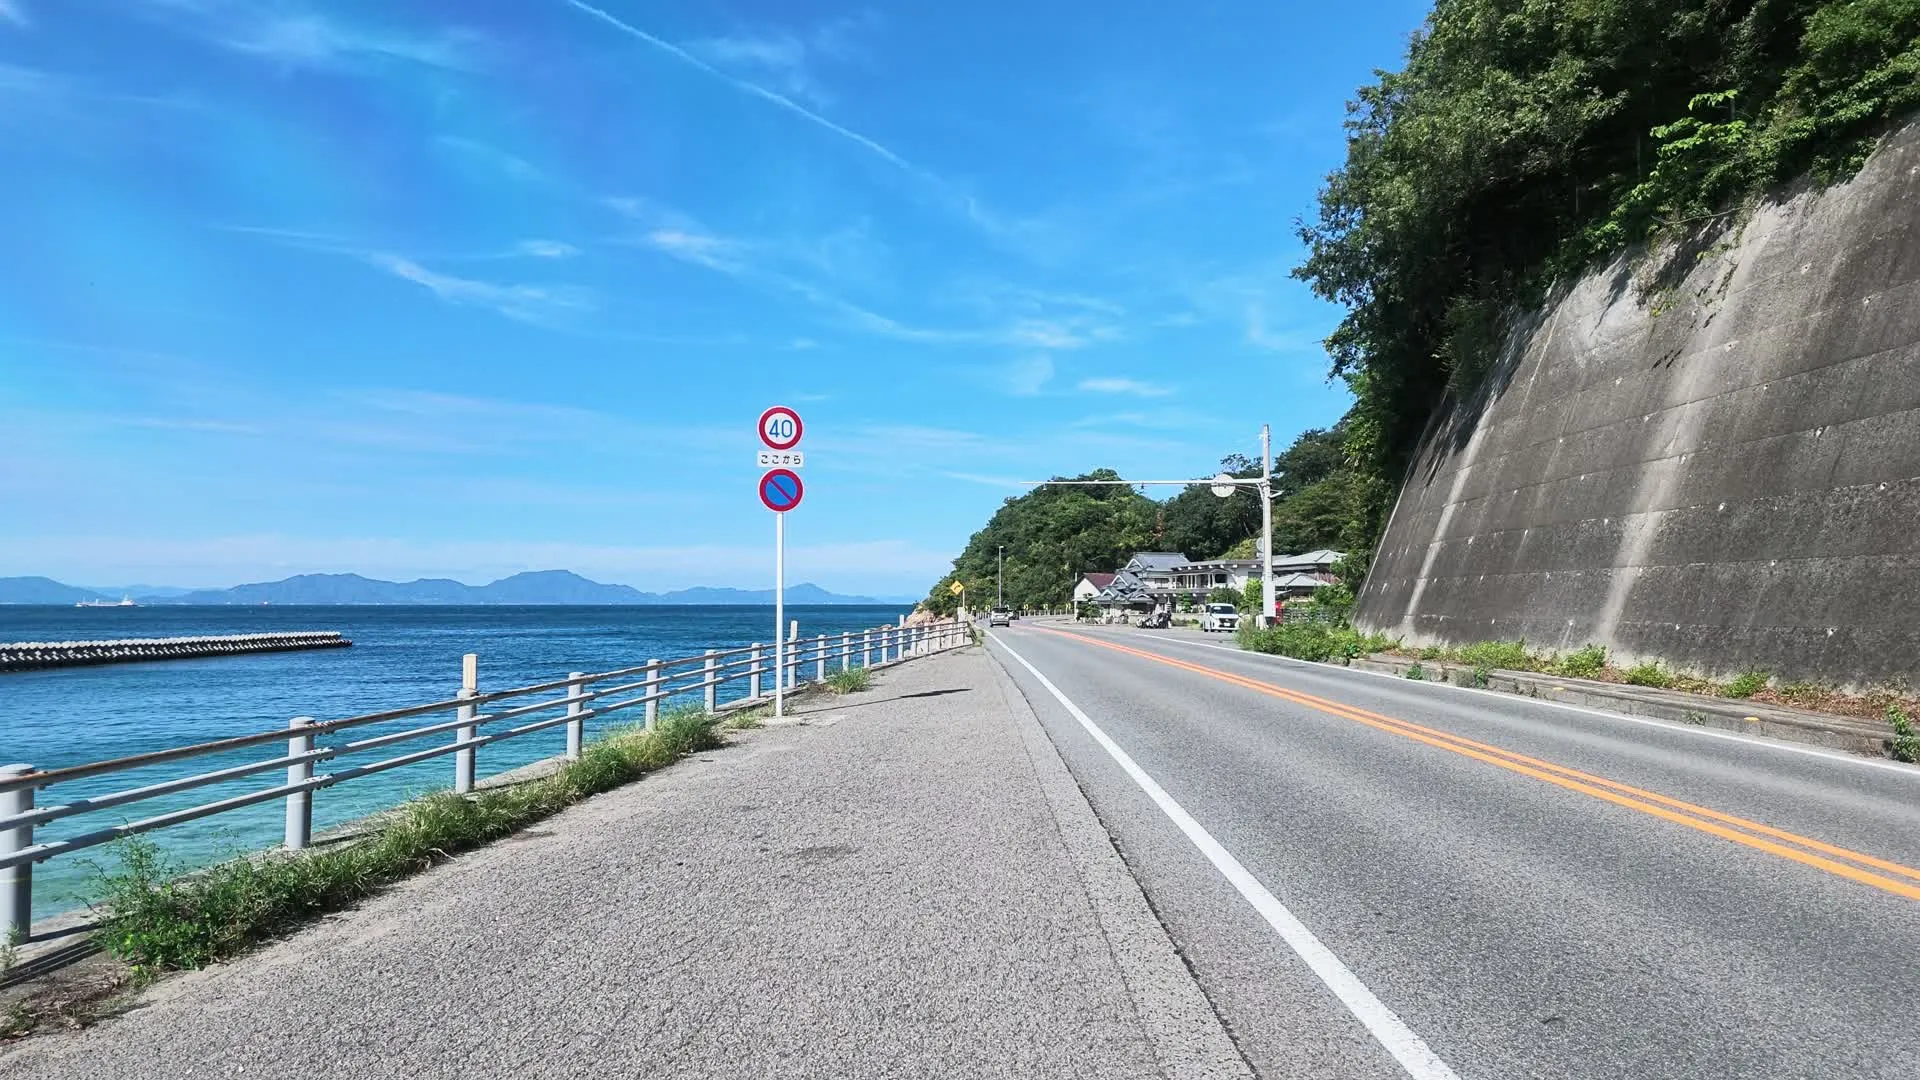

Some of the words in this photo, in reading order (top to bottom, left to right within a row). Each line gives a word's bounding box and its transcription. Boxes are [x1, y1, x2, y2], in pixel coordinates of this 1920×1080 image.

[769, 419, 793, 438] 40
[761, 454, 801, 465] ここから
